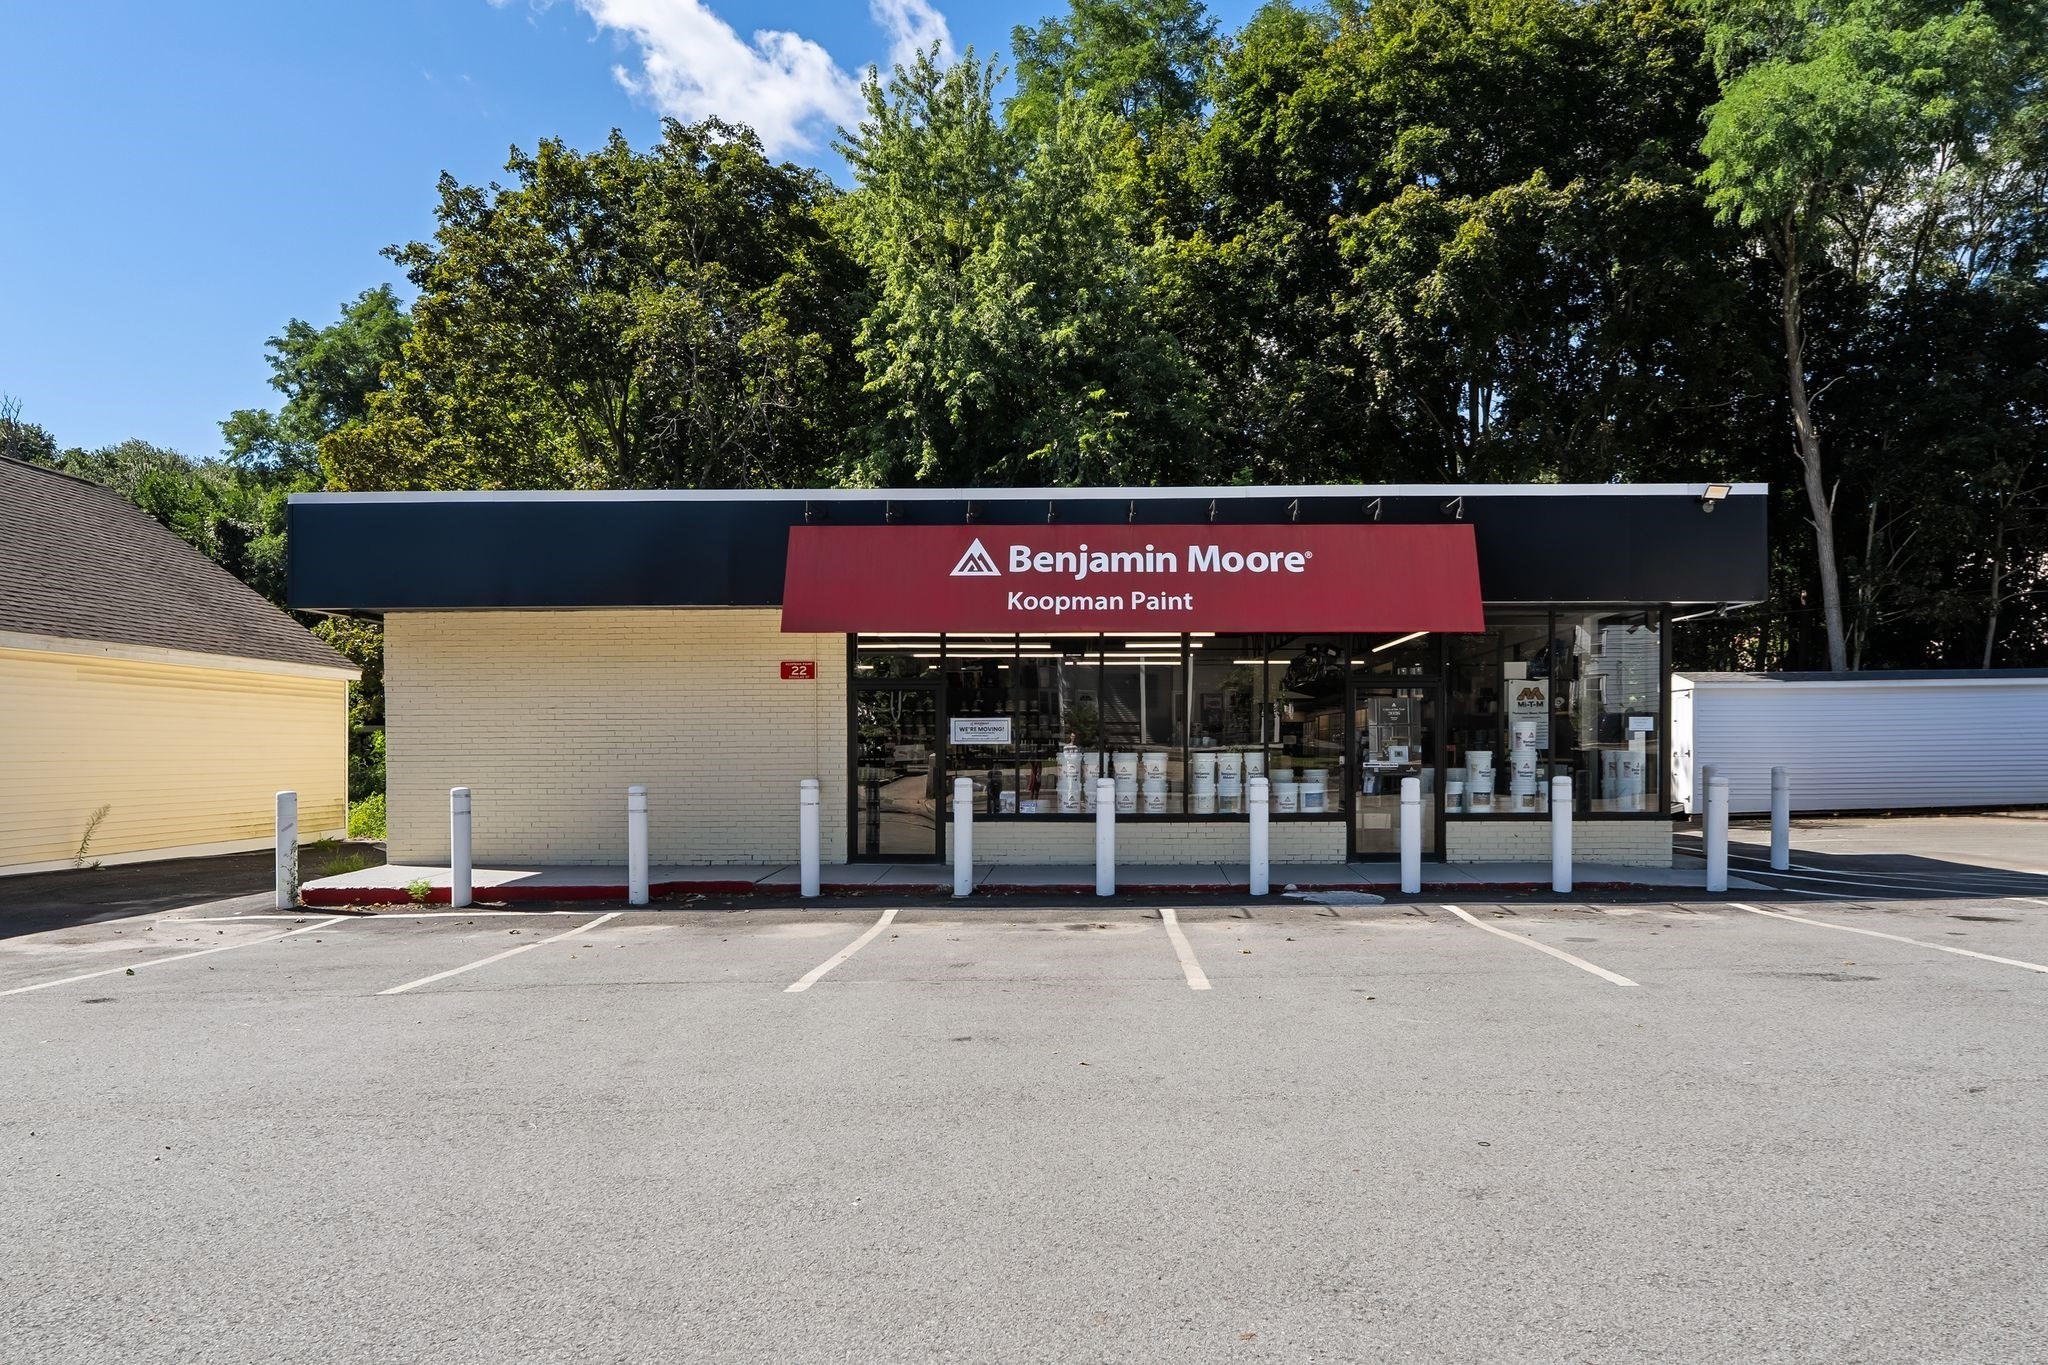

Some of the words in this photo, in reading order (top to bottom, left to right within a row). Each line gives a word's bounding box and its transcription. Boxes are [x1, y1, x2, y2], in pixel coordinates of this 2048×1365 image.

[1009, 544, 1177, 581] Benjamin
[1007, 591, 1124, 615] Koopman
[1131, 591, 1193, 611] Paint
[791, 665, 807, 675] 22
